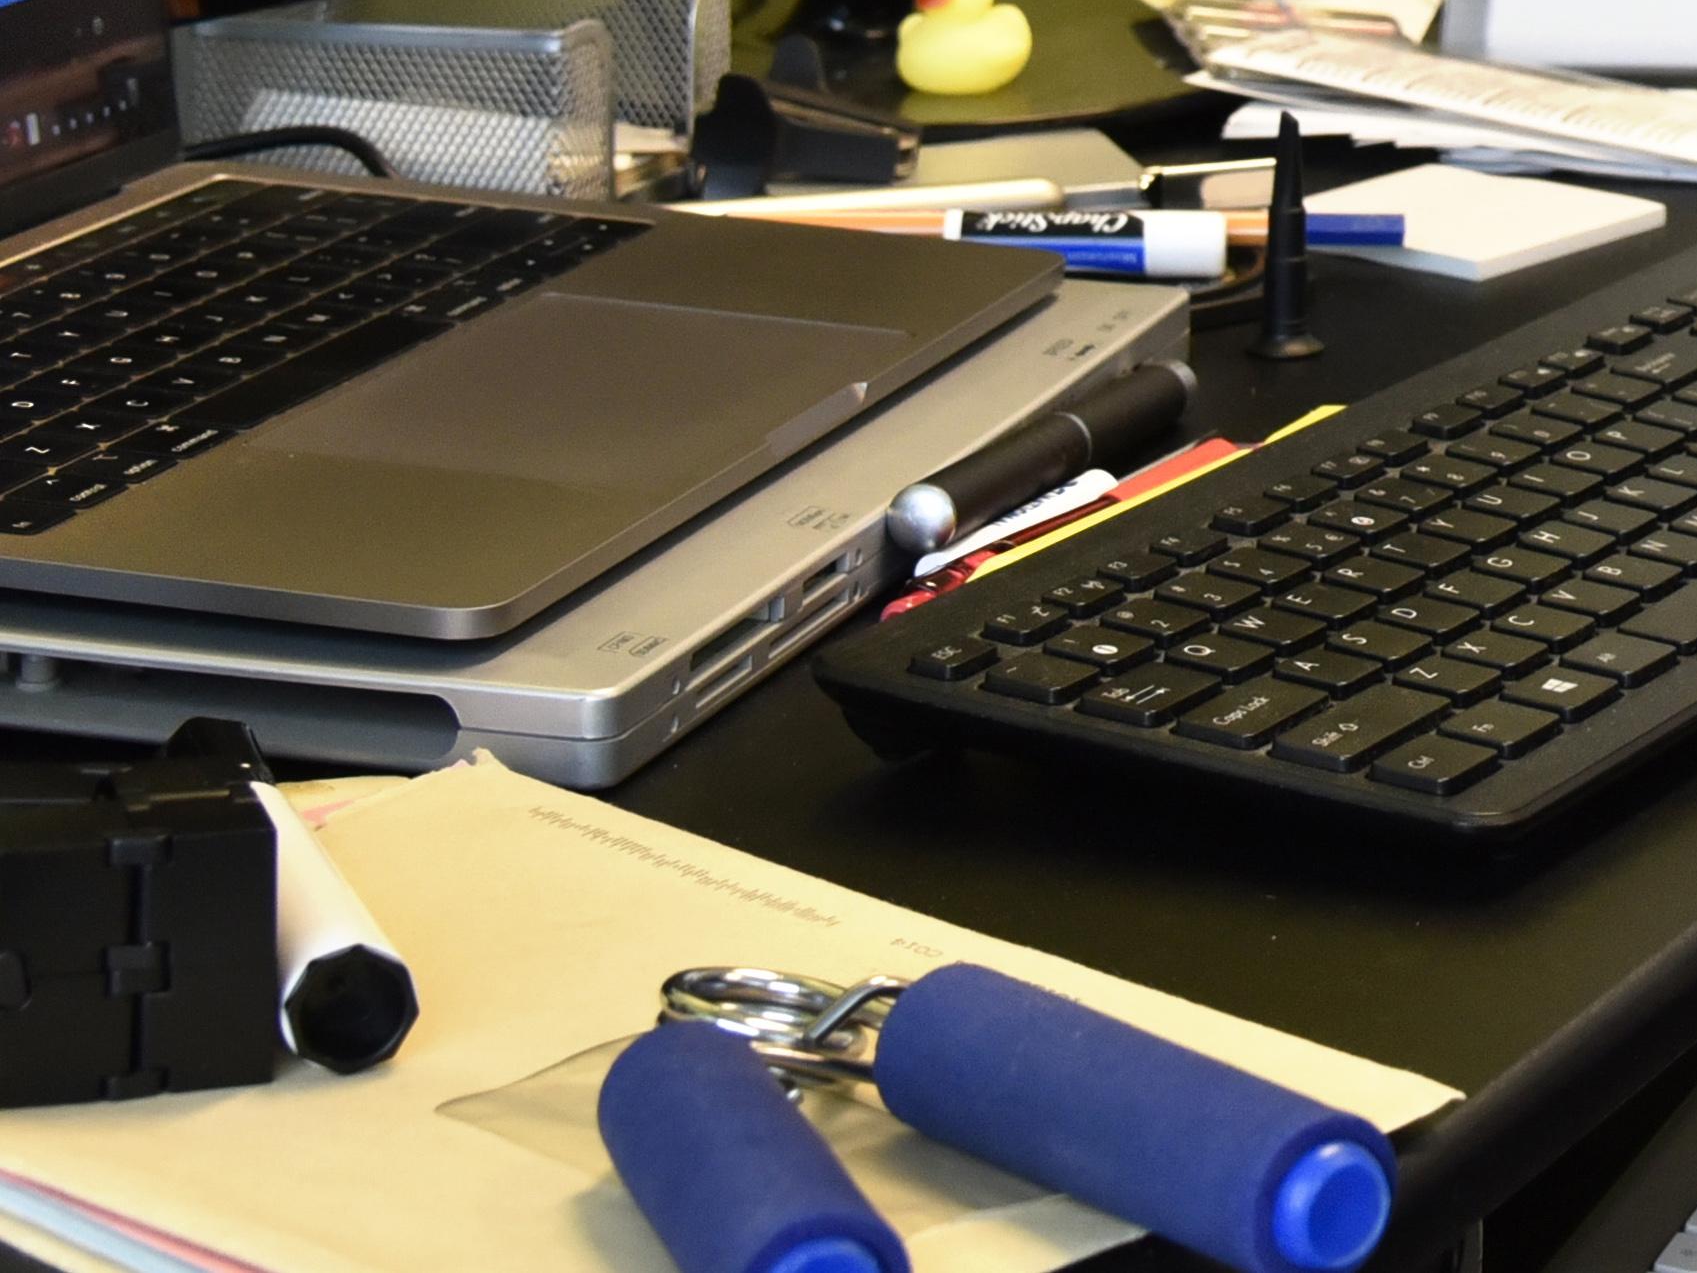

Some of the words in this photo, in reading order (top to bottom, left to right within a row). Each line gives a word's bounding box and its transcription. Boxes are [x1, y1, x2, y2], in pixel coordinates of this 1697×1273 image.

[1607, 430, 1628, 441] P
[1566, 450, 1591, 461] O
[1660, 467, 1684, 476] L
[1618, 485, 1645, 497] K
[1476, 494, 1503, 505] U
[1577, 511, 1599, 521] J
[1430, 518, 1454, 529] Y
[1532, 530, 1560, 544] H
[1382, 543, 1406, 553] T
[1640, 539, 1668, 552] N
[1487, 556, 1513, 568] G
[1336, 567, 1364, 578] R
[1597, 565, 1623, 576] B
[1438, 582, 1460, 595] F
[1286, 593, 1313, 605] E
[1551, 589, 1577, 602] V
[1391, 607, 1417, 619] D
[1233, 615, 1266, 631] W
[1508, 615, 1534, 627] C
[1342, 632, 1367, 645] S
[1183, 645, 1216, 655] Q
[1457, 641, 1487, 654] X
[1292, 659, 1320, 672] A
[1409, 666, 1439, 680] Z
[1213, 706, 1247, 726] Caps
